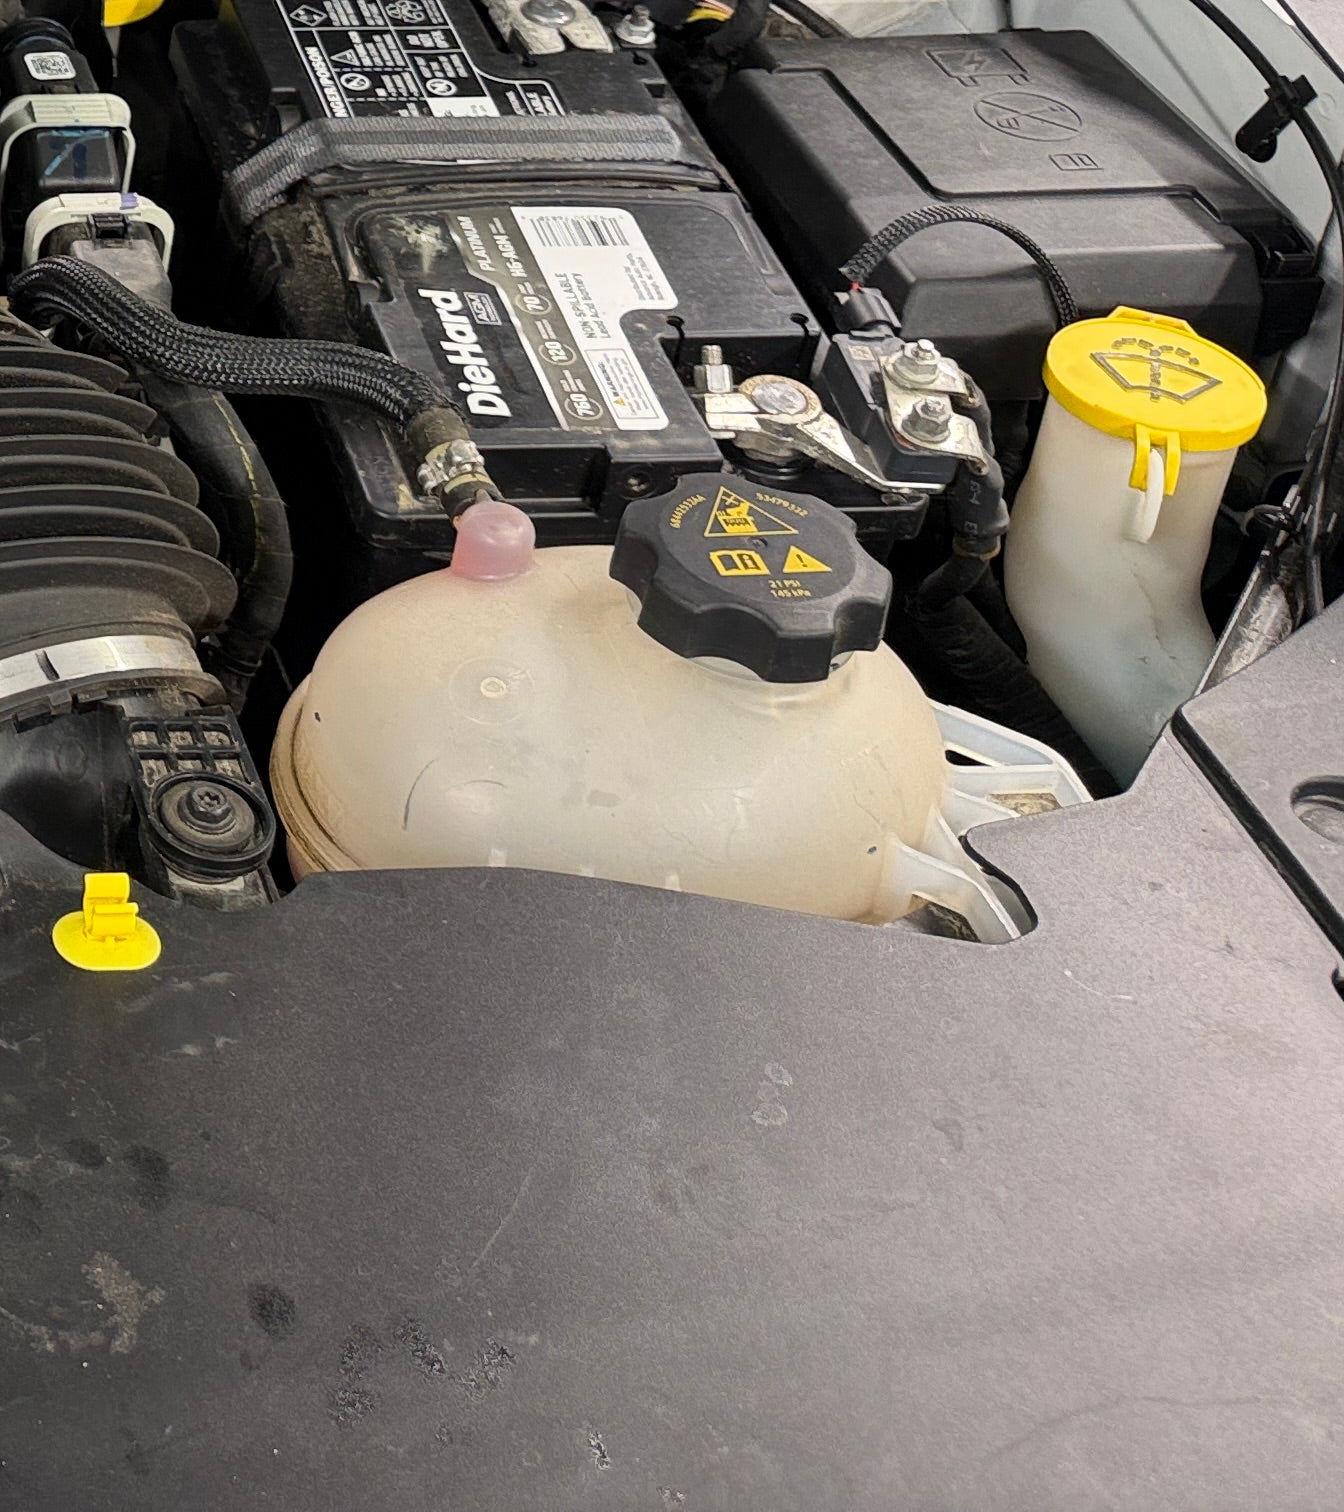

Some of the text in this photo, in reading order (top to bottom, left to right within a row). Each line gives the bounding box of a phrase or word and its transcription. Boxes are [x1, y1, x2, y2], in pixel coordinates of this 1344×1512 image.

[457, 216, 496, 272] PLATINUM
[496, 234, 528, 278] H6-AGM
[468, 294, 488, 324] AGM
[523, 295, 545, 311] 70
[554, 273, 598, 339] NON-SPILLABLE
[418, 288, 514, 418] DieHard
[544, 341, 569, 362] 120
[569, 393, 595, 419] 760
